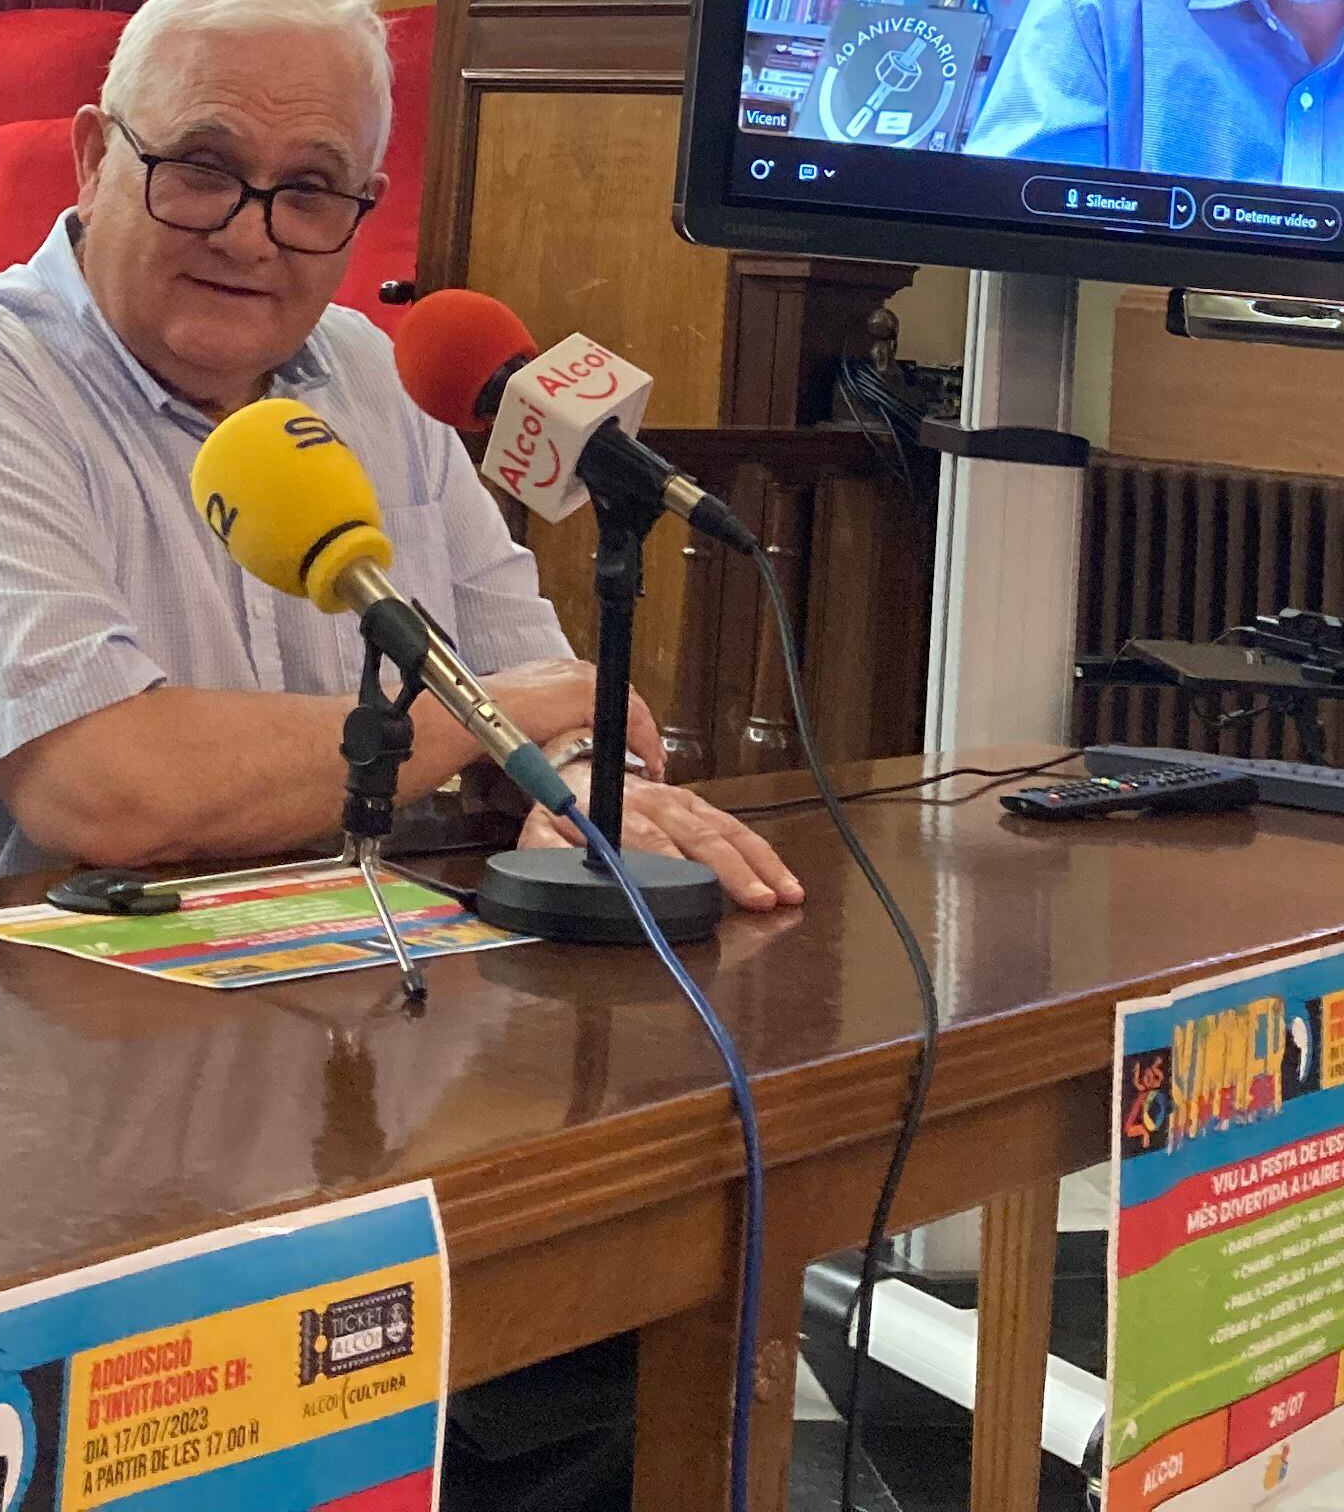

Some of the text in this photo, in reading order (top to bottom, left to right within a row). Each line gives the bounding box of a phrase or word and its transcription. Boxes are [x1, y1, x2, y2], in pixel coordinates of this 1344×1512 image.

[835, 17, 957, 78] 40 ANIVERSARIO
[746, 109, 787, 128] Vicent
[1086, 194, 1138, 212] Silenciar
[1235, 208, 1317, 229] Detener vídeo
[536, 343, 614, 397] Alcoi
[499, 397, 547, 496] Alcoi
[1213, 1172, 1239, 1196] VIU
[1261, 1149, 1298, 1179] FESTA
[1300, 1144, 1318, 1166] DE
[1220, 1180, 1289, 1224] DIVERTIDA
[1291, 1175, 1301, 1197] A
[1303, 1161, 1340, 1192] L'AIRE
[332, 1306, 384, 1335] TICKET
[335, 1330, 382, 1355] ALCOI
[90, 1330, 193, 1392] ADQUISICIÓ
[87, 1357, 252, 1430] D'INVITACIONS EN:
[303, 1374, 406, 1419] ALCOI CULTURA
[1268, 1392, 1305, 1429] 26/07
[83, 1418, 260, 1498] A PARTIR DE LES 17.00 H
[84, 1406, 210, 1465] DIA 17/07/2023
[1142, 1452, 1185, 1497] ALCOI
